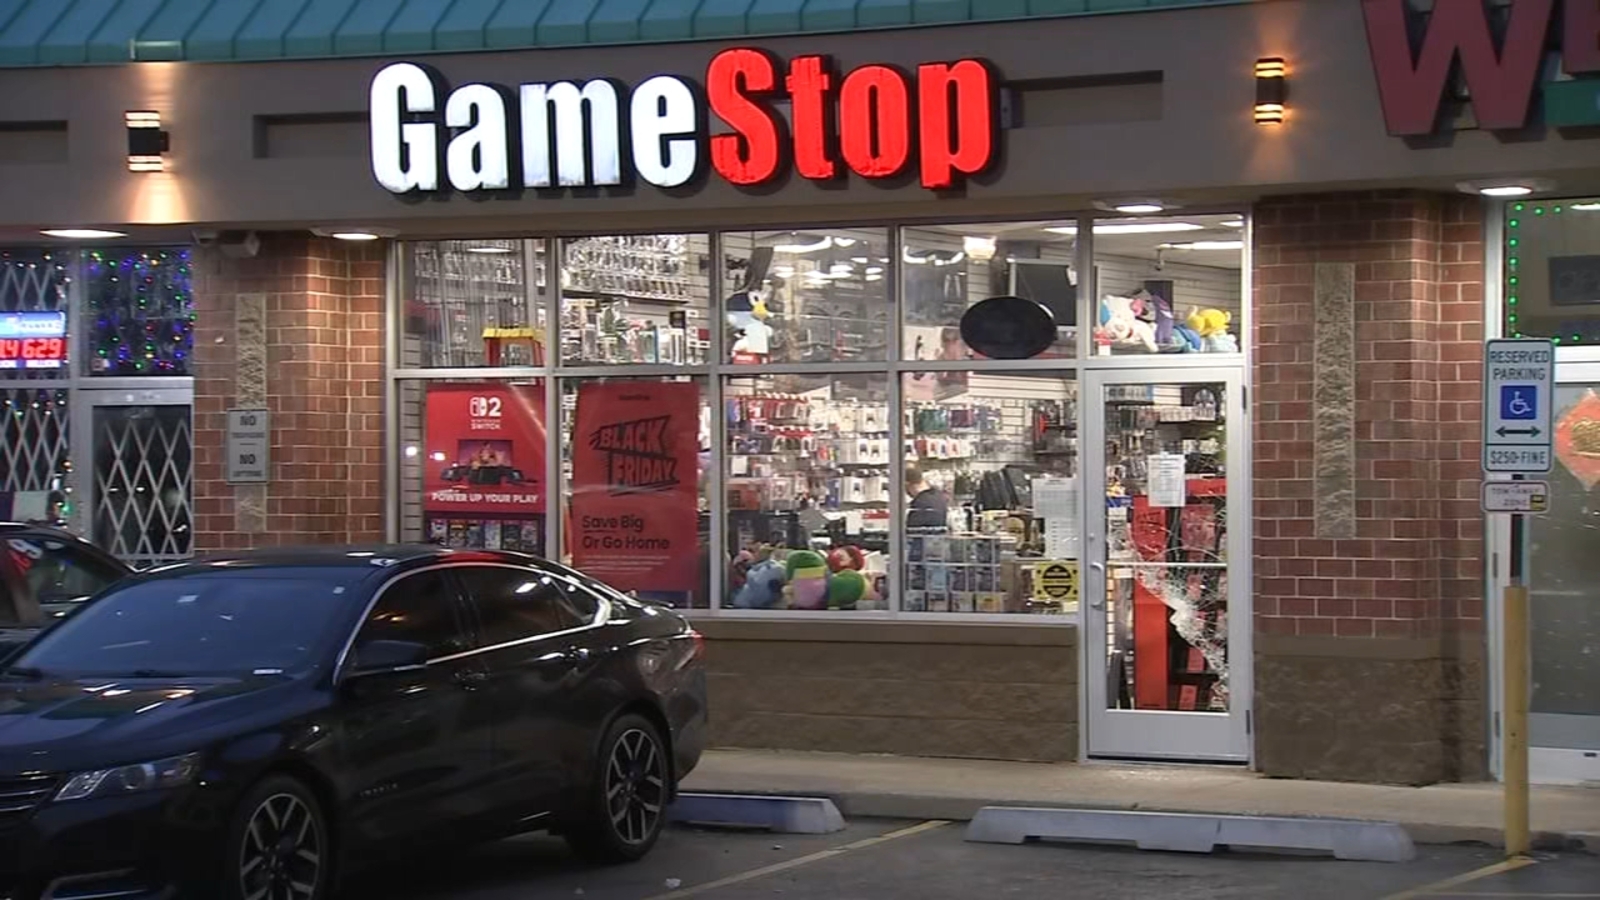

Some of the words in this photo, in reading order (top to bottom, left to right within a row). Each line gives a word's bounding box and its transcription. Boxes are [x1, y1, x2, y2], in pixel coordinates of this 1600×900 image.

[369, 48, 991, 193] GameStop
[22, 338, 62, 358] 629
[1490, 350, 1549, 363] RESERVED
[1493, 367, 1546, 380] PARKING
[488, 396, 502, 417] 2
[239, 415, 257, 426] NO
[600, 418, 664, 452] BLACK
[239, 454, 256, 465] NO
[611, 453, 677, 483] FRIDAY
[431, 492, 467, 502] POWER
[469, 493, 483, 502] UP
[485, 494, 511, 503] YOUR
[513, 494, 538, 503] PLAY
[582, 515, 618, 529] Save
[620, 514, 644, 532] Big
[582, 535, 600, 549] Or
[602, 536, 623, 549] Go
[625, 537, 670, 549] Home
